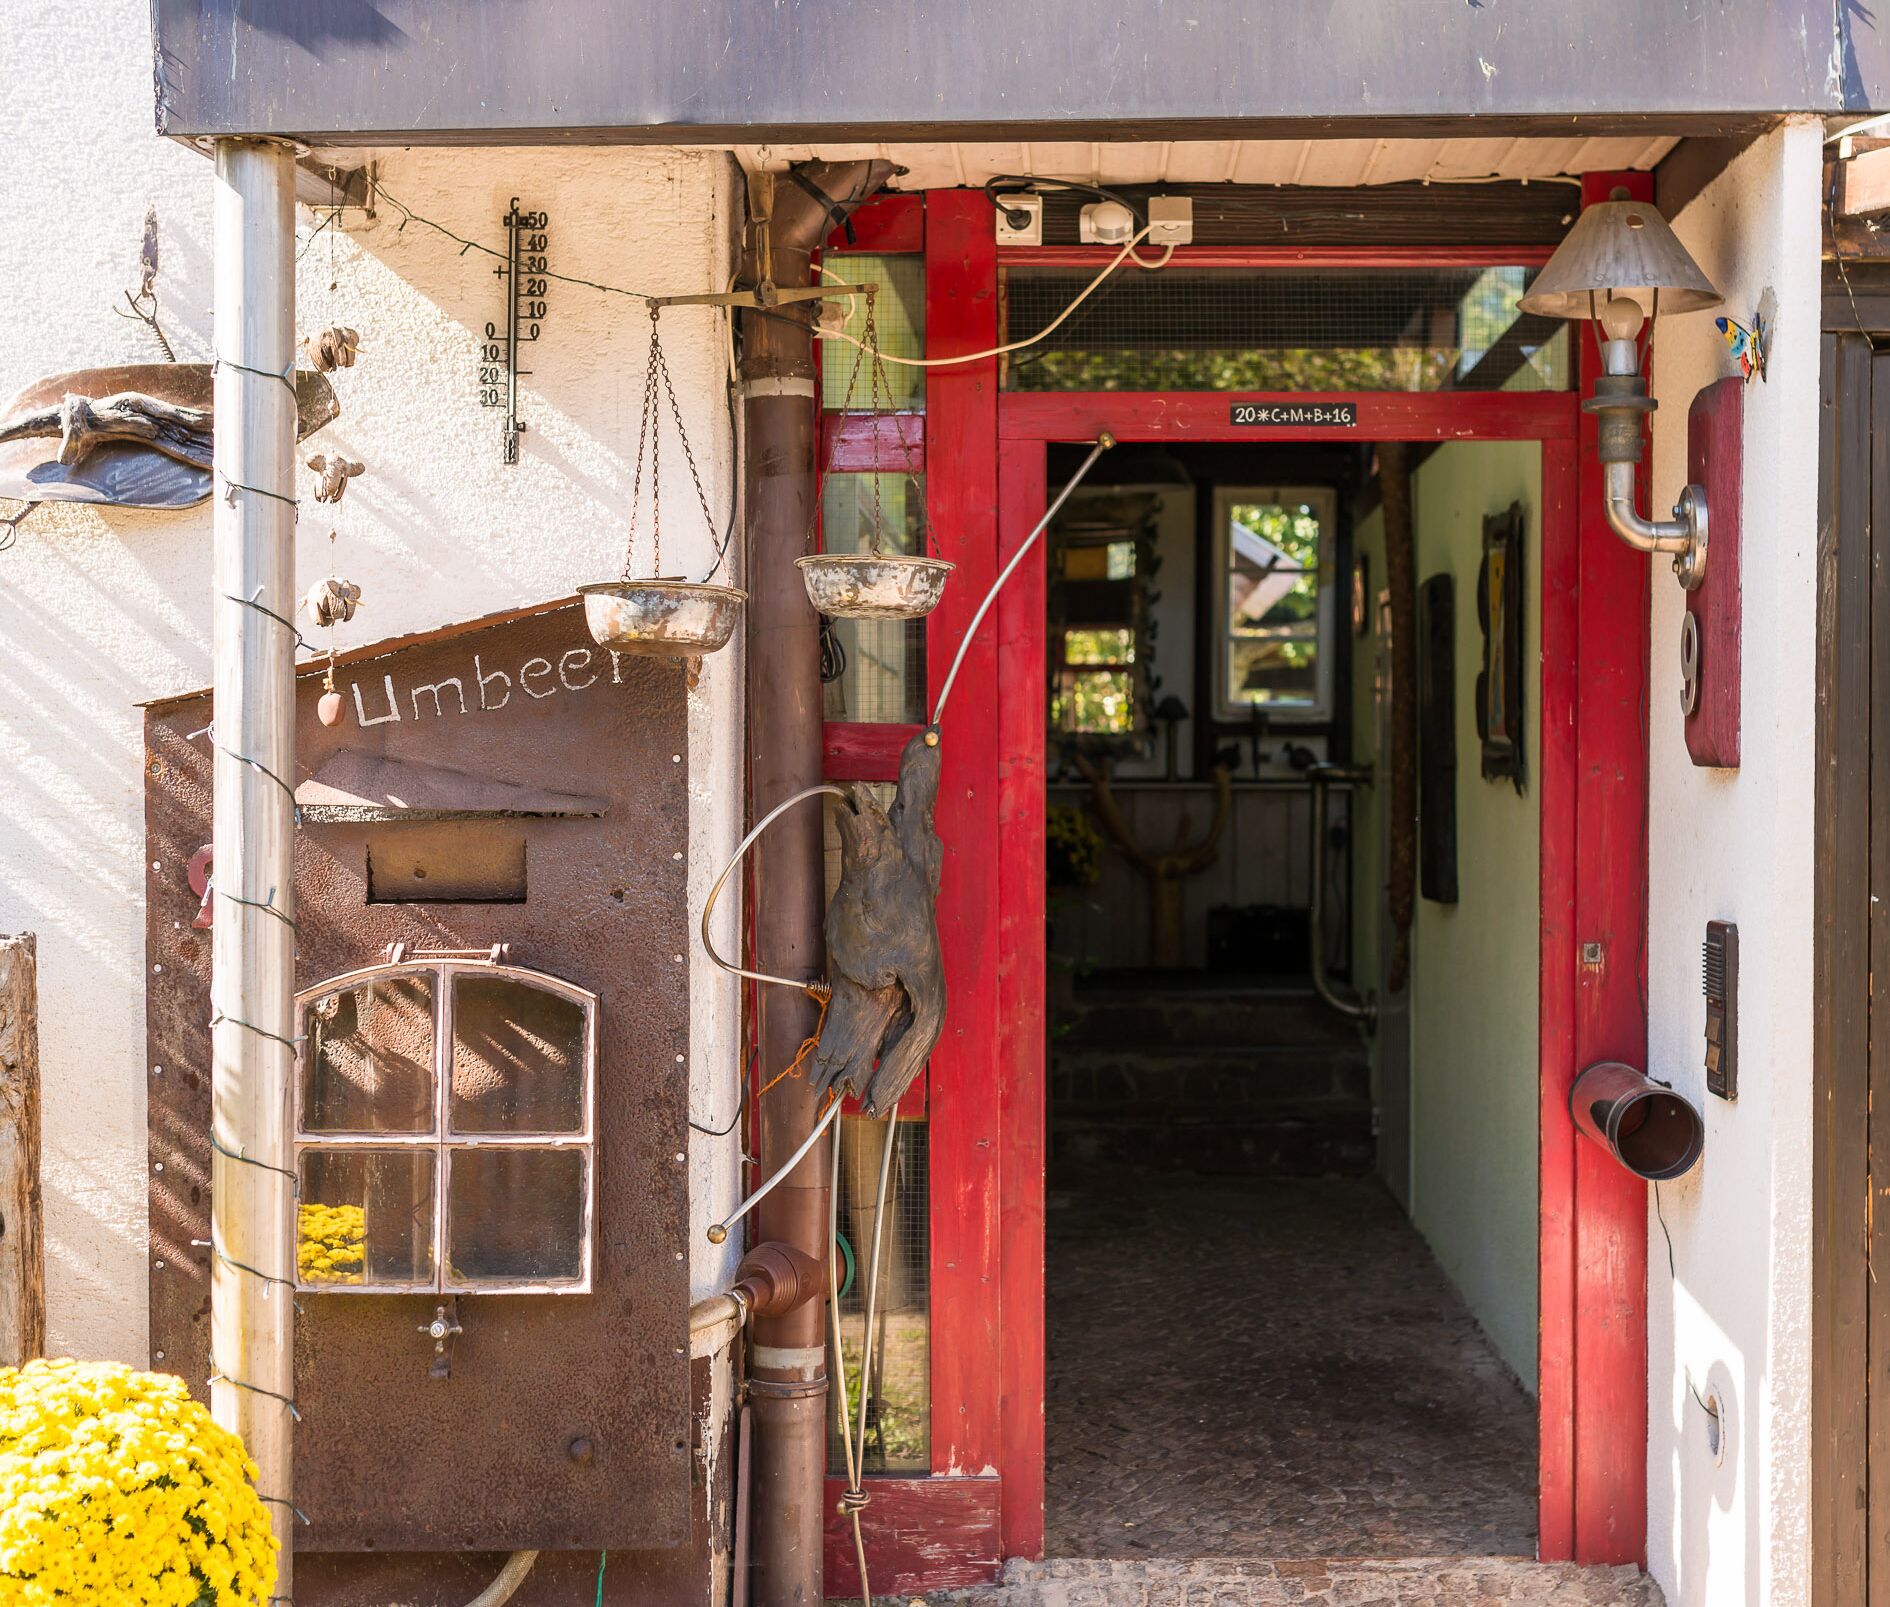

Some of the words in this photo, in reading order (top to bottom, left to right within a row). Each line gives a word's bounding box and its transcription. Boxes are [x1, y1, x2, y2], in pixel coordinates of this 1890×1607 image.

[509, 197, 520, 212] C
[528, 211, 549, 228] 50
[528, 234, 548, 251] 40
[528, 256, 548, 273] 30
[527, 278, 548, 295] 20
[529, 301, 547, 317] 10
[485, 322, 496, 338] 0
[530, 323, 541, 340] 0
[481, 344, 500, 360] 10
[480, 367, 499, 382] 20
[480, 389, 499, 405] 30
[1680, 610, 1698, 717] 9
